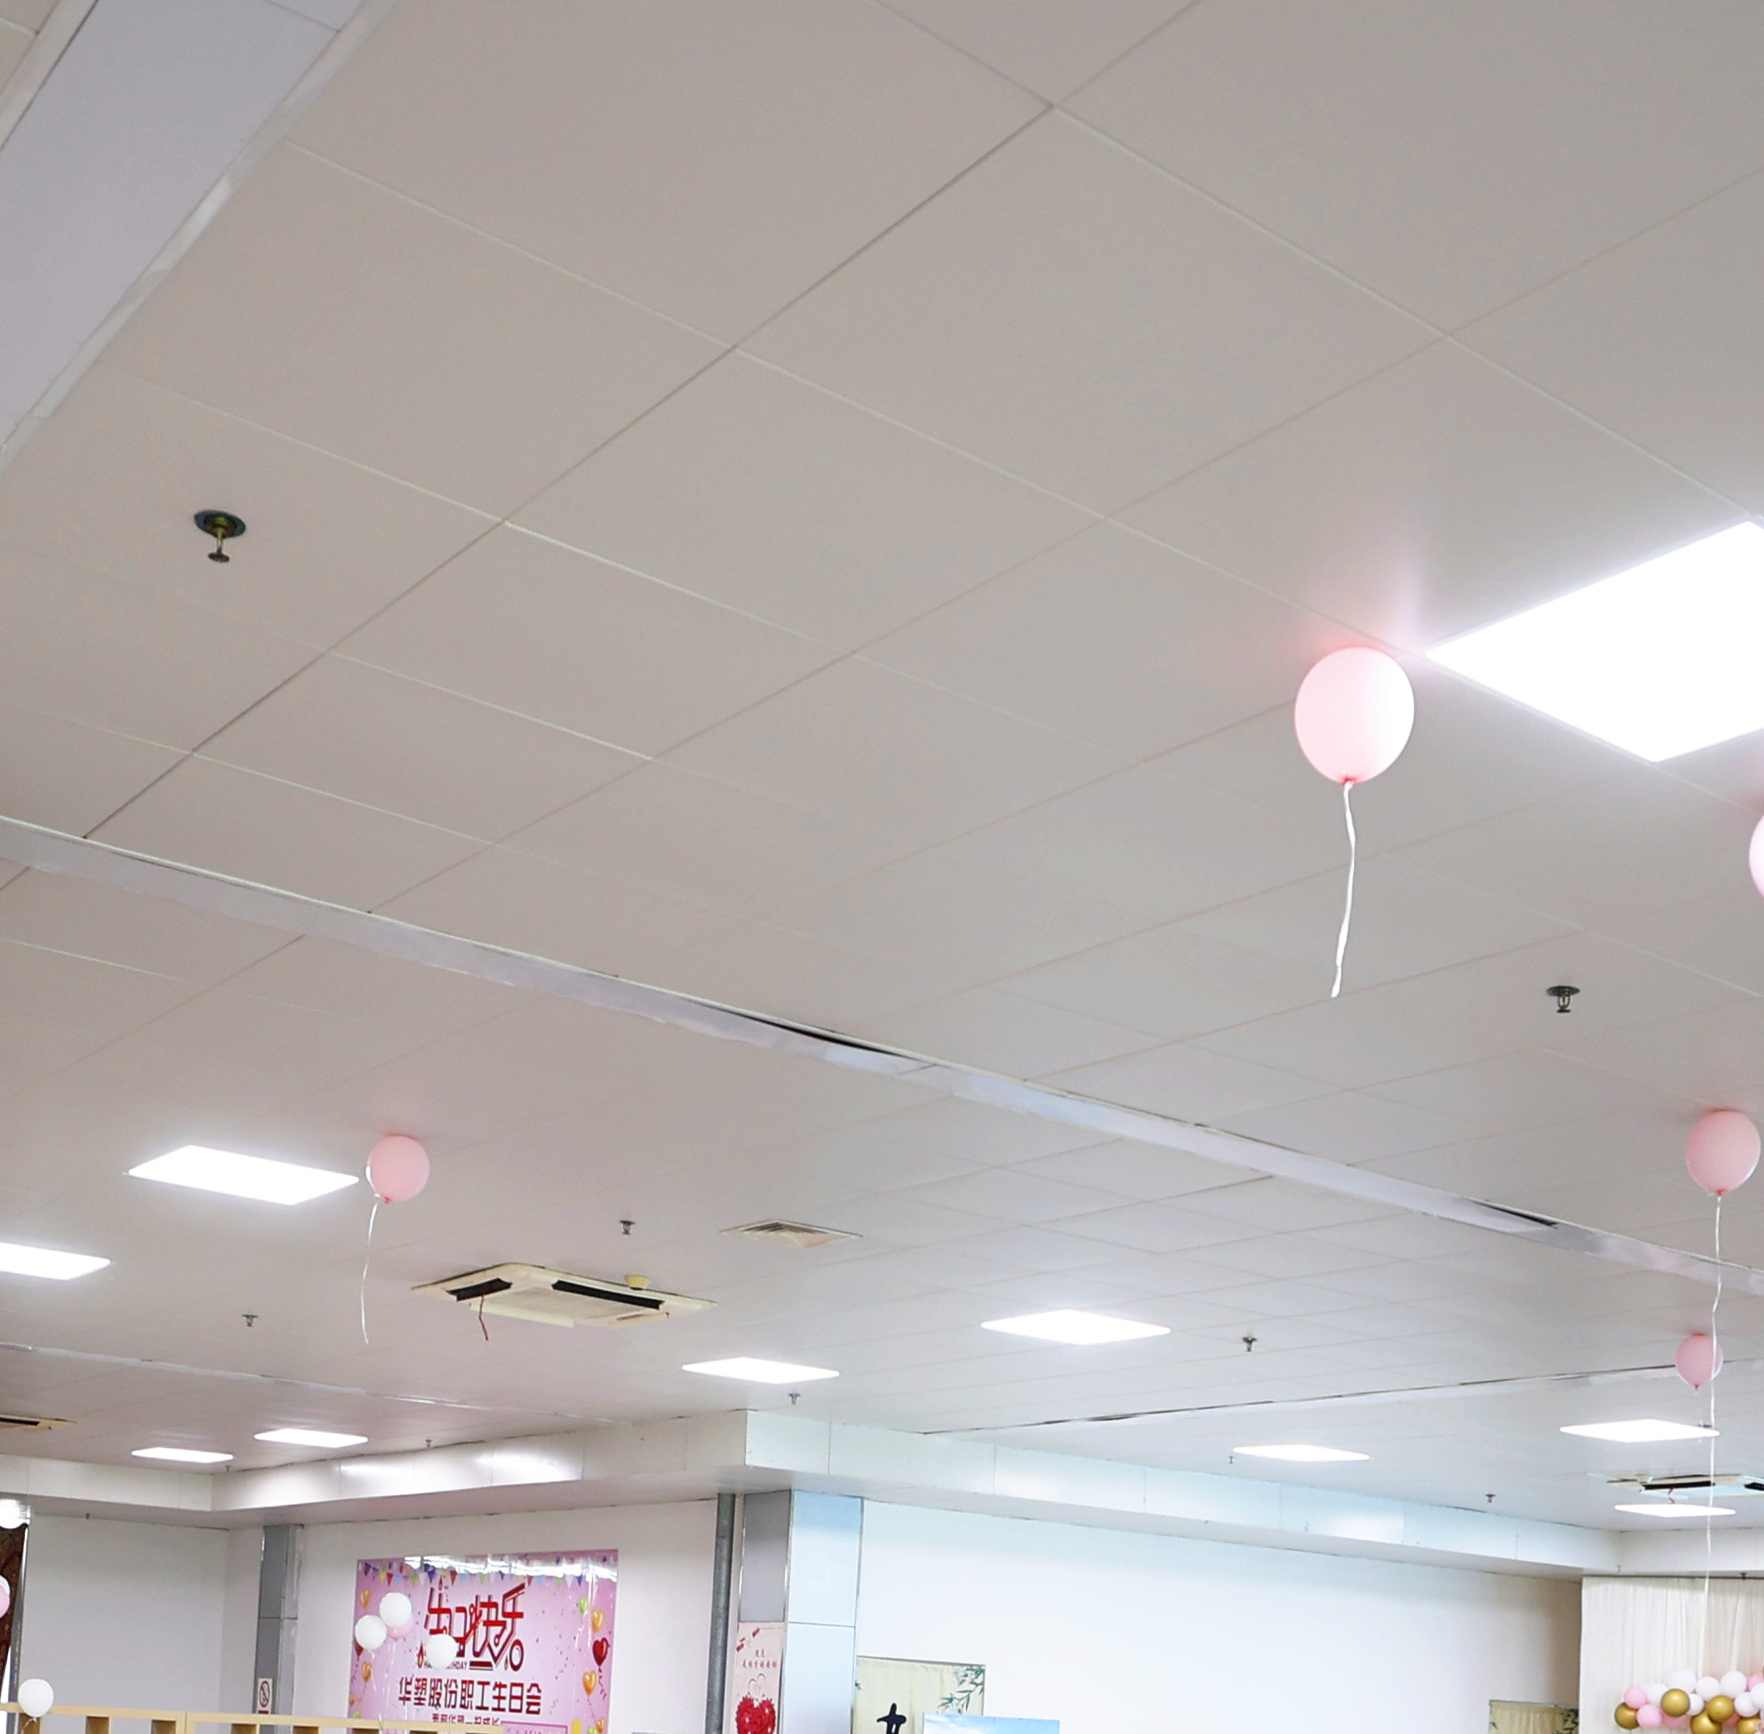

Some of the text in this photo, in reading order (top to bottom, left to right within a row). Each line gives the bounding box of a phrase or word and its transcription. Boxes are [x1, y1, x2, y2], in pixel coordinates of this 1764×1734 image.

[399, 1677, 542, 1715] 华塑股份职工生日会
